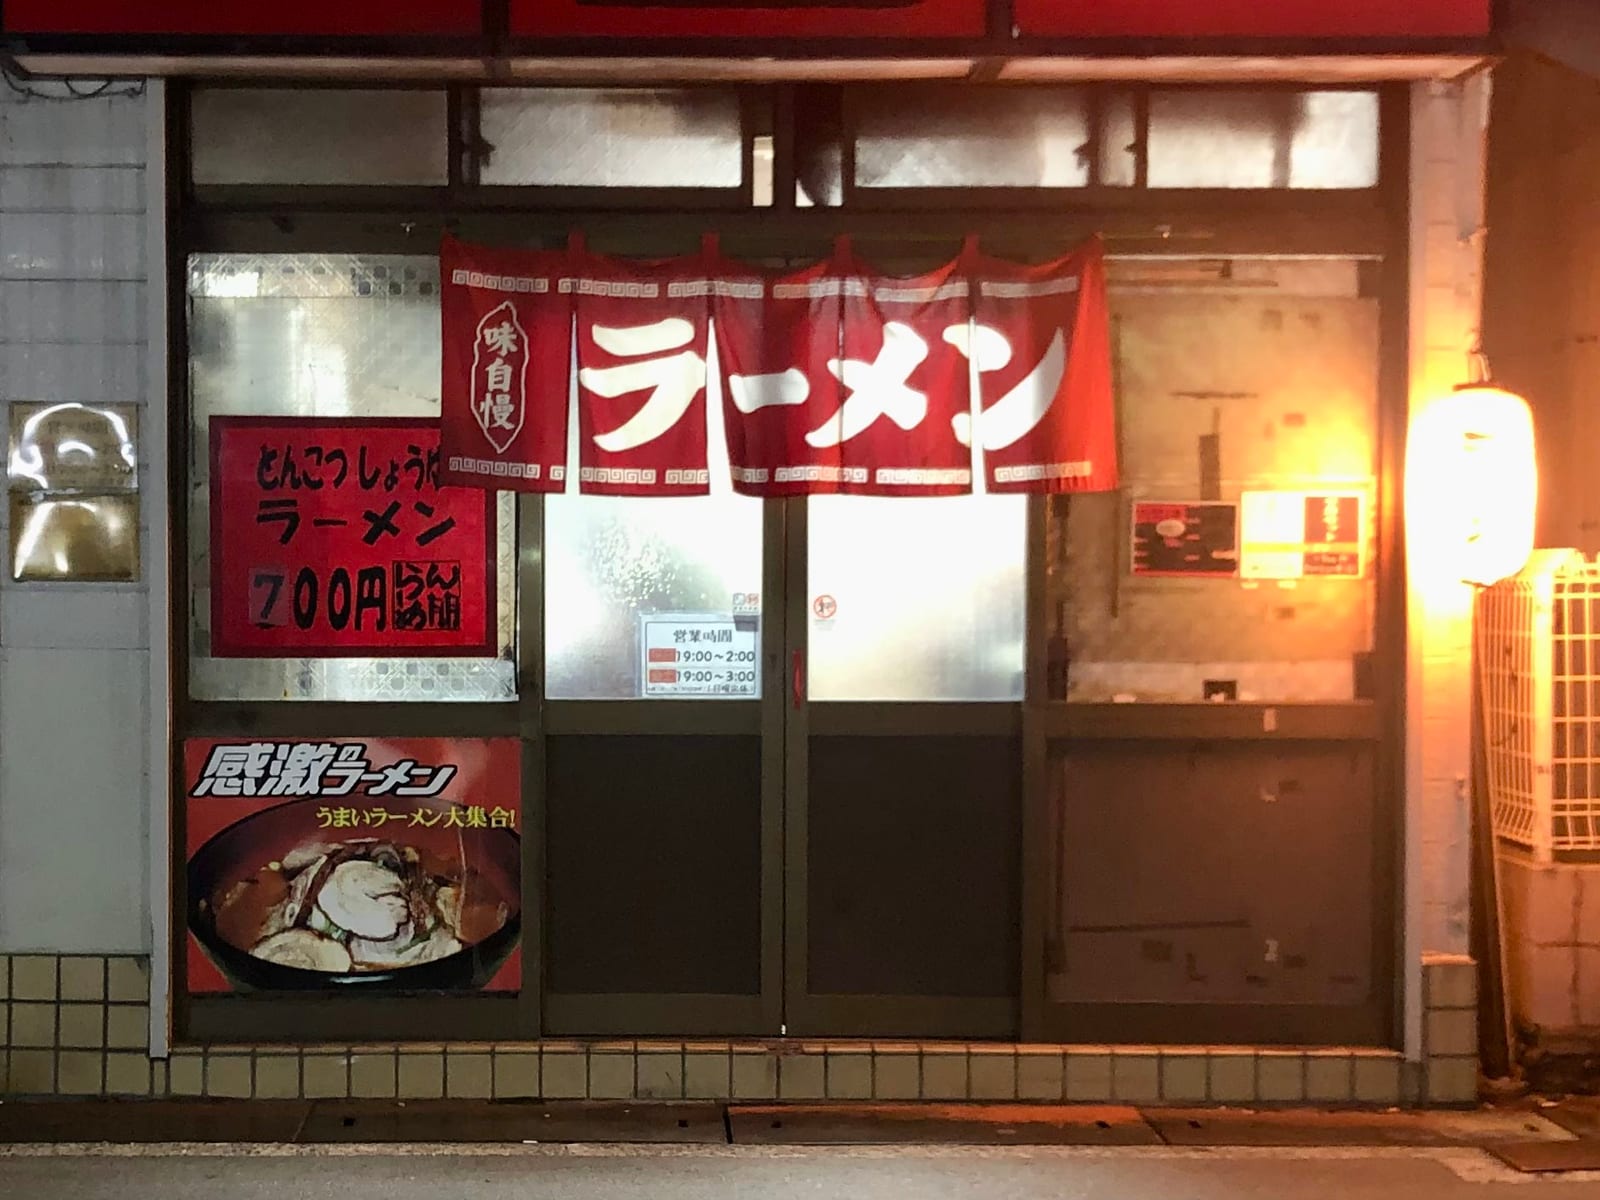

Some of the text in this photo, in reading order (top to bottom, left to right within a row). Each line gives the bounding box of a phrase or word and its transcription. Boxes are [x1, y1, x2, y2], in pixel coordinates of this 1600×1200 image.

[480, 321, 518, 430] 味自慢
[580, 317, 1065, 452] ラーメン
[257, 500, 456, 546] ラーメン
[253, 566, 387, 632] 700円
[193, 743, 454, 796] 感激のラーメン
[316, 806, 516, 829] うまいラーメン大集合!
